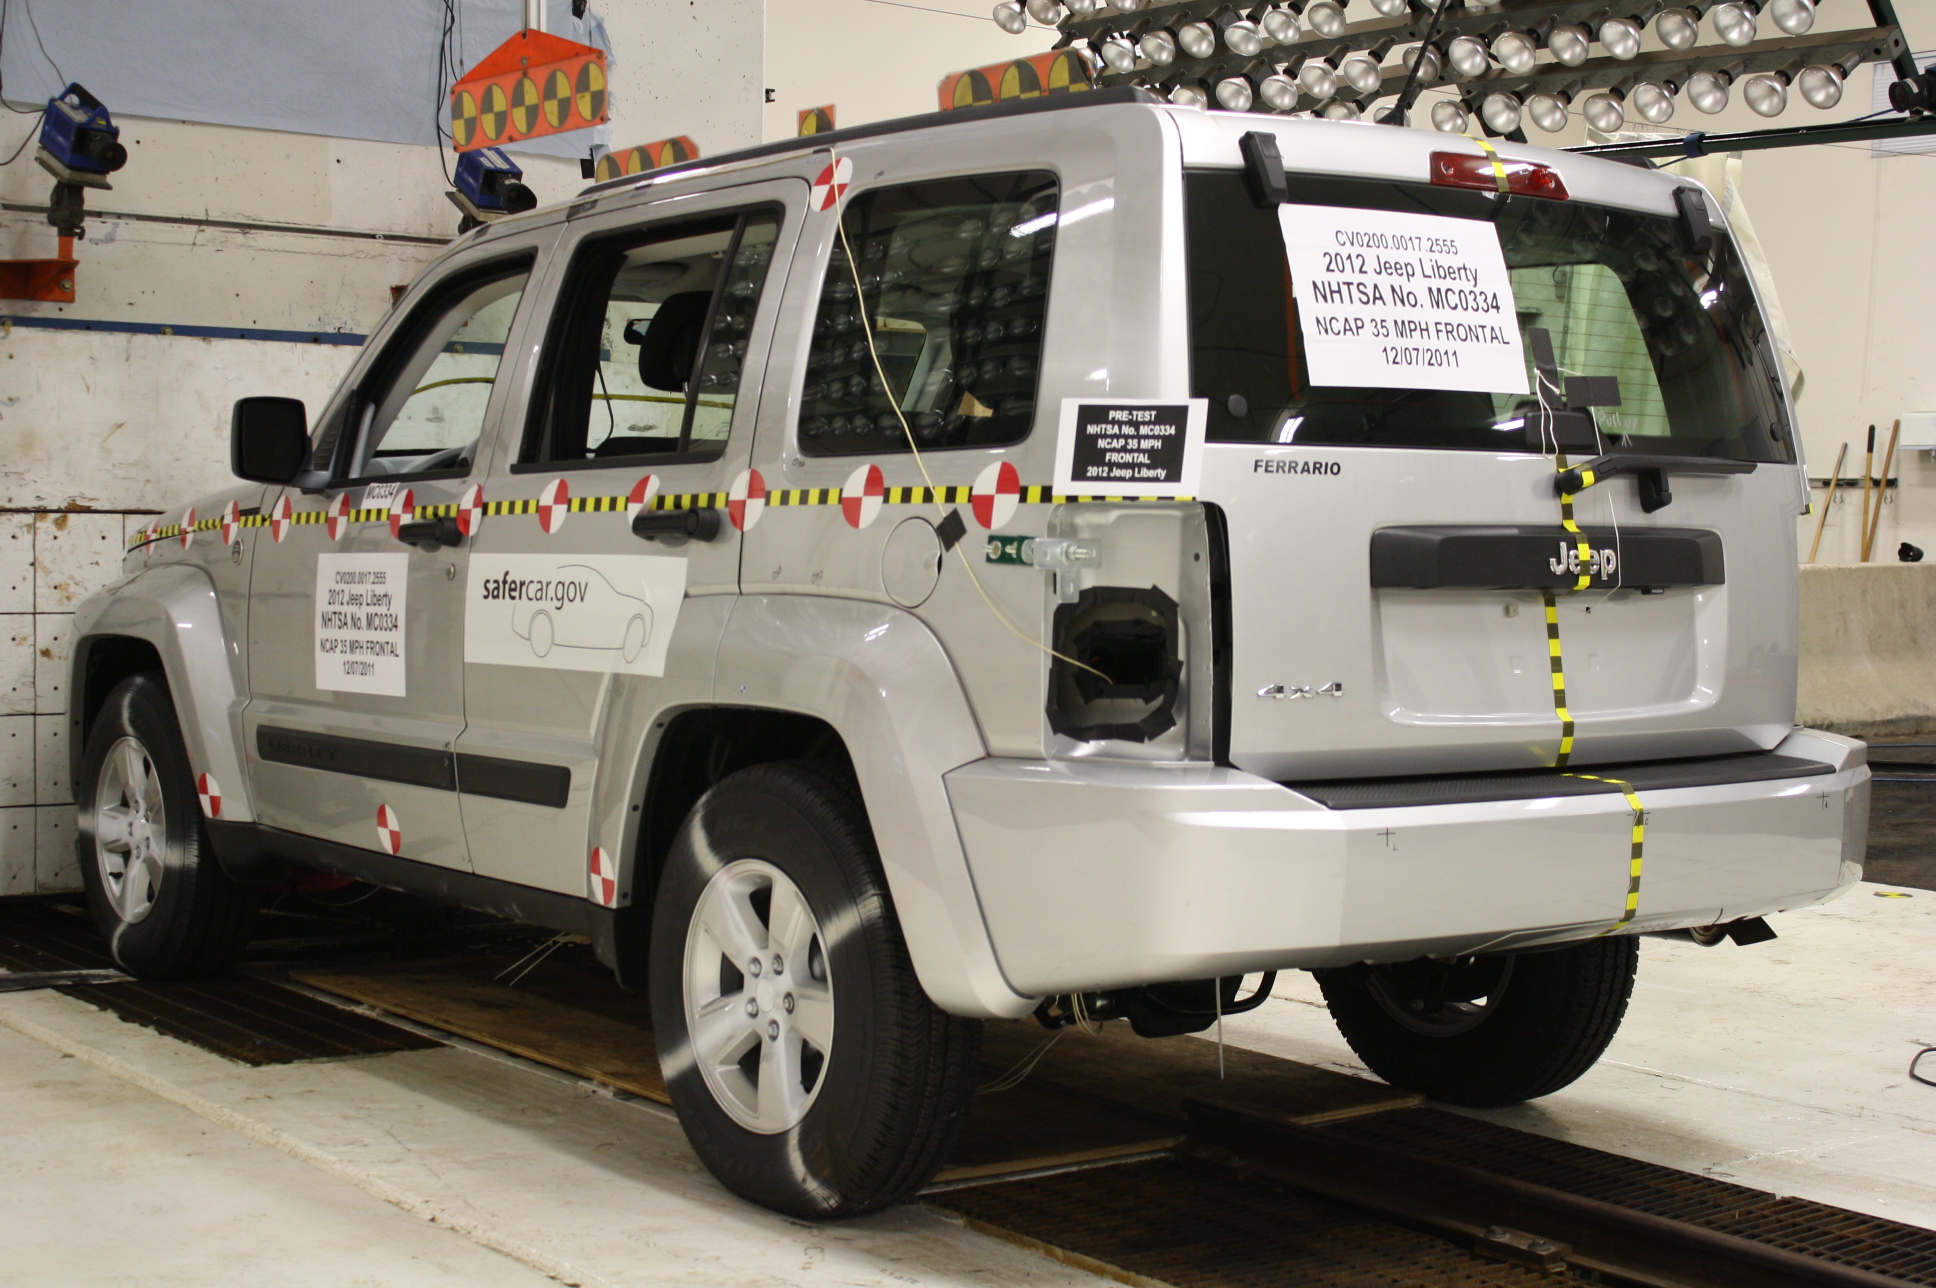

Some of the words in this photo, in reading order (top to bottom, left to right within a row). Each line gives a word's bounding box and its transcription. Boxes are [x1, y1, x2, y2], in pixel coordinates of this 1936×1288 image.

[1335, 230, 1458, 255] CV0200.0017.2555
[1323, 252, 1368, 274] 2012
[1374, 255, 1415, 282] Jeep
[1419, 258, 1478, 287] Liberty
[1312, 280, 1387, 306] NHTSA
[1390, 284, 1424, 308] No.
[1428, 287, 1500, 314] MC0334
[1315, 316, 1365, 336] NCAP
[1370, 318, 1389, 338] 35
[1393, 319, 1431, 340] MPH
[1434, 322, 1510, 345] FRONTAL
[1382, 347, 1459, 368] 12/07/2011
[1108, 410, 1157, 421] PRE-TEST
[1086, 424, 1120, 435] NHTSA
[1121, 425, 1137, 435] No.
[1139, 425, 1176, 436] MC0334
[1097, 438, 1125, 449] NCAP
[1126, 439, 1138, 449] 35
[1140, 439, 1162, 450] MPH
[1105, 452, 1151, 463] FRONTAL
[1253, 459, 1341, 476] FERRARIO
[1086, 466, 1108, 477] 2012
[1110, 466, 1132, 479] Jeep
[1134, 467, 1167, 480] Liberty
[1549, 542, 1617, 580] Jeep
[483, 570, 588, 610] safercar.gov
[328, 589, 345, 606] 2012
[346, 589, 364, 610] Jeep
[365, 590, 392, 612] Liberty
[321, 611, 349, 630] NHTSA
[350, 612, 364, 631] No.
[366, 612, 398, 632] MC0334
[320, 638, 339, 654] NCAP
[340, 639, 348, 654] 35
[349, 640, 364, 655] MPH
[366, 641, 400, 658] FRONTAL
[343, 661, 375, 677] 12/07/2011
[1257, 681, 1344, 700] 4x4
